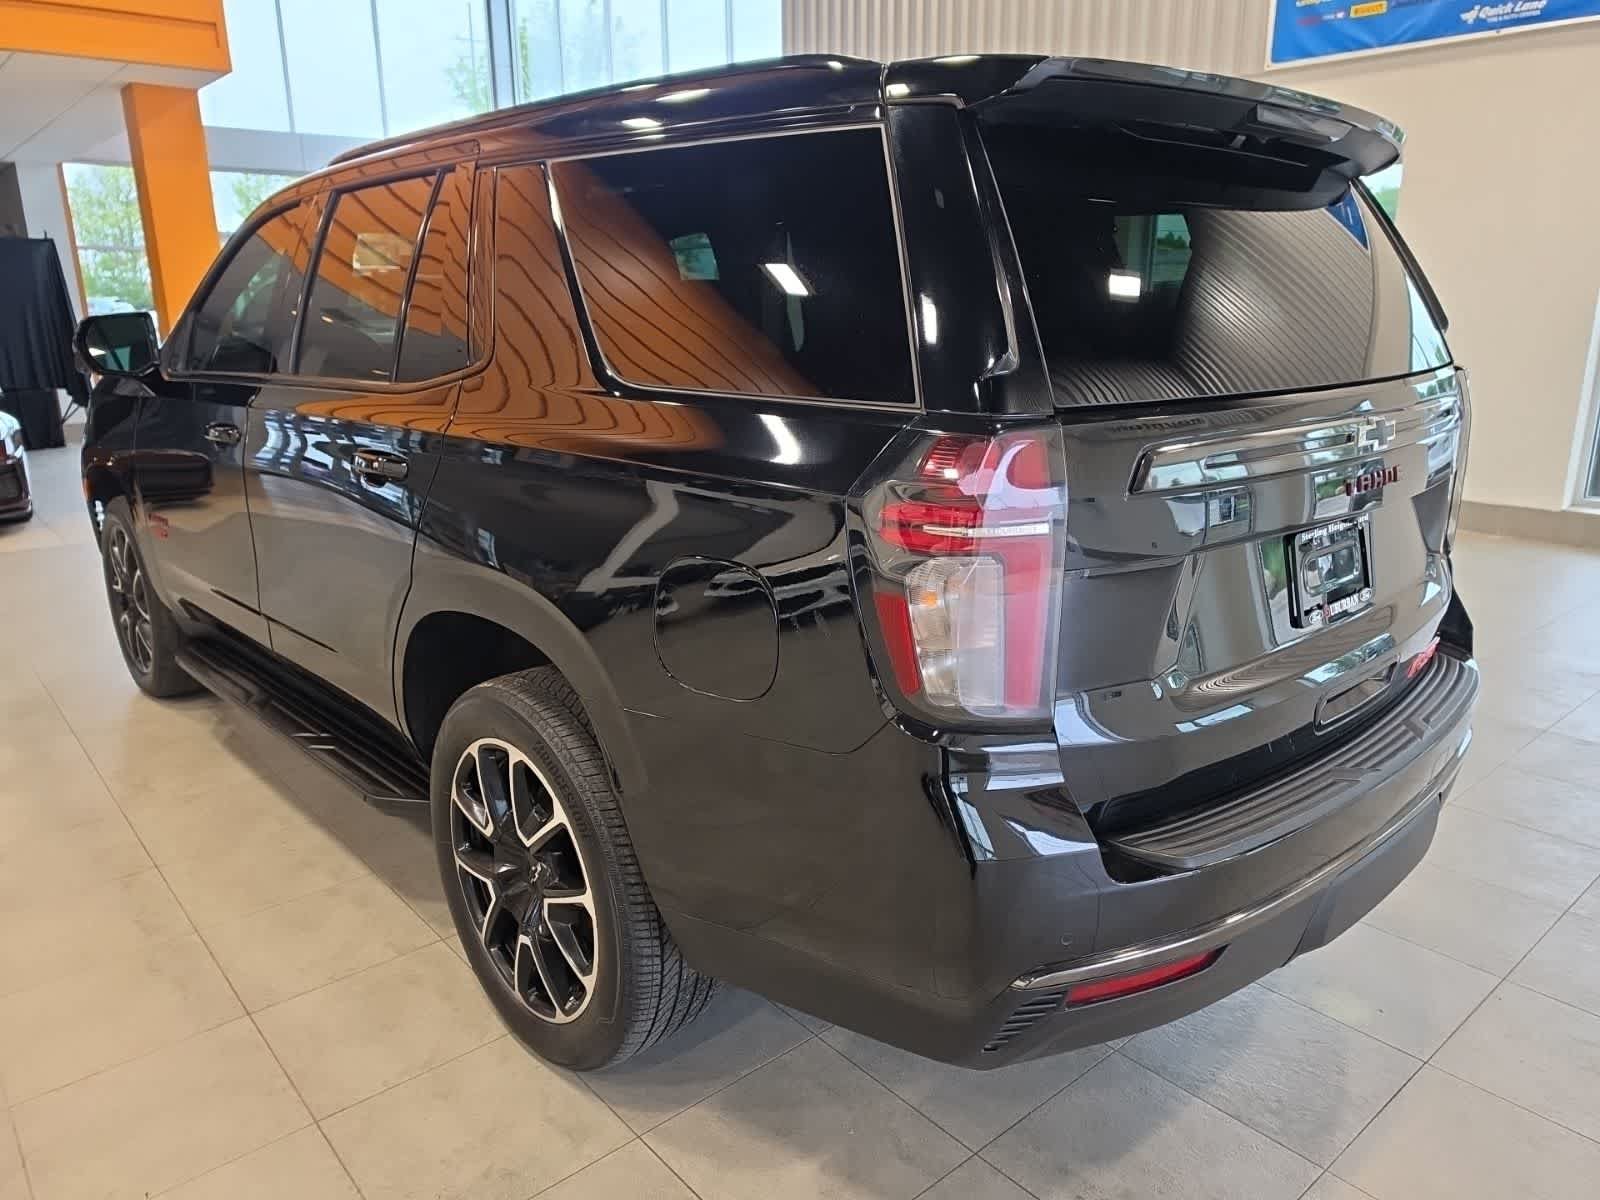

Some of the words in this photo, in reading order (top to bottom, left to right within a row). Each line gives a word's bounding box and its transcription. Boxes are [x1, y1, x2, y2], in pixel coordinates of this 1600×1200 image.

[1479, 3, 1515, 19] Quick
[1513, 0, 1548, 12] Lane
[1301, 527, 1328, 543] Sterling
